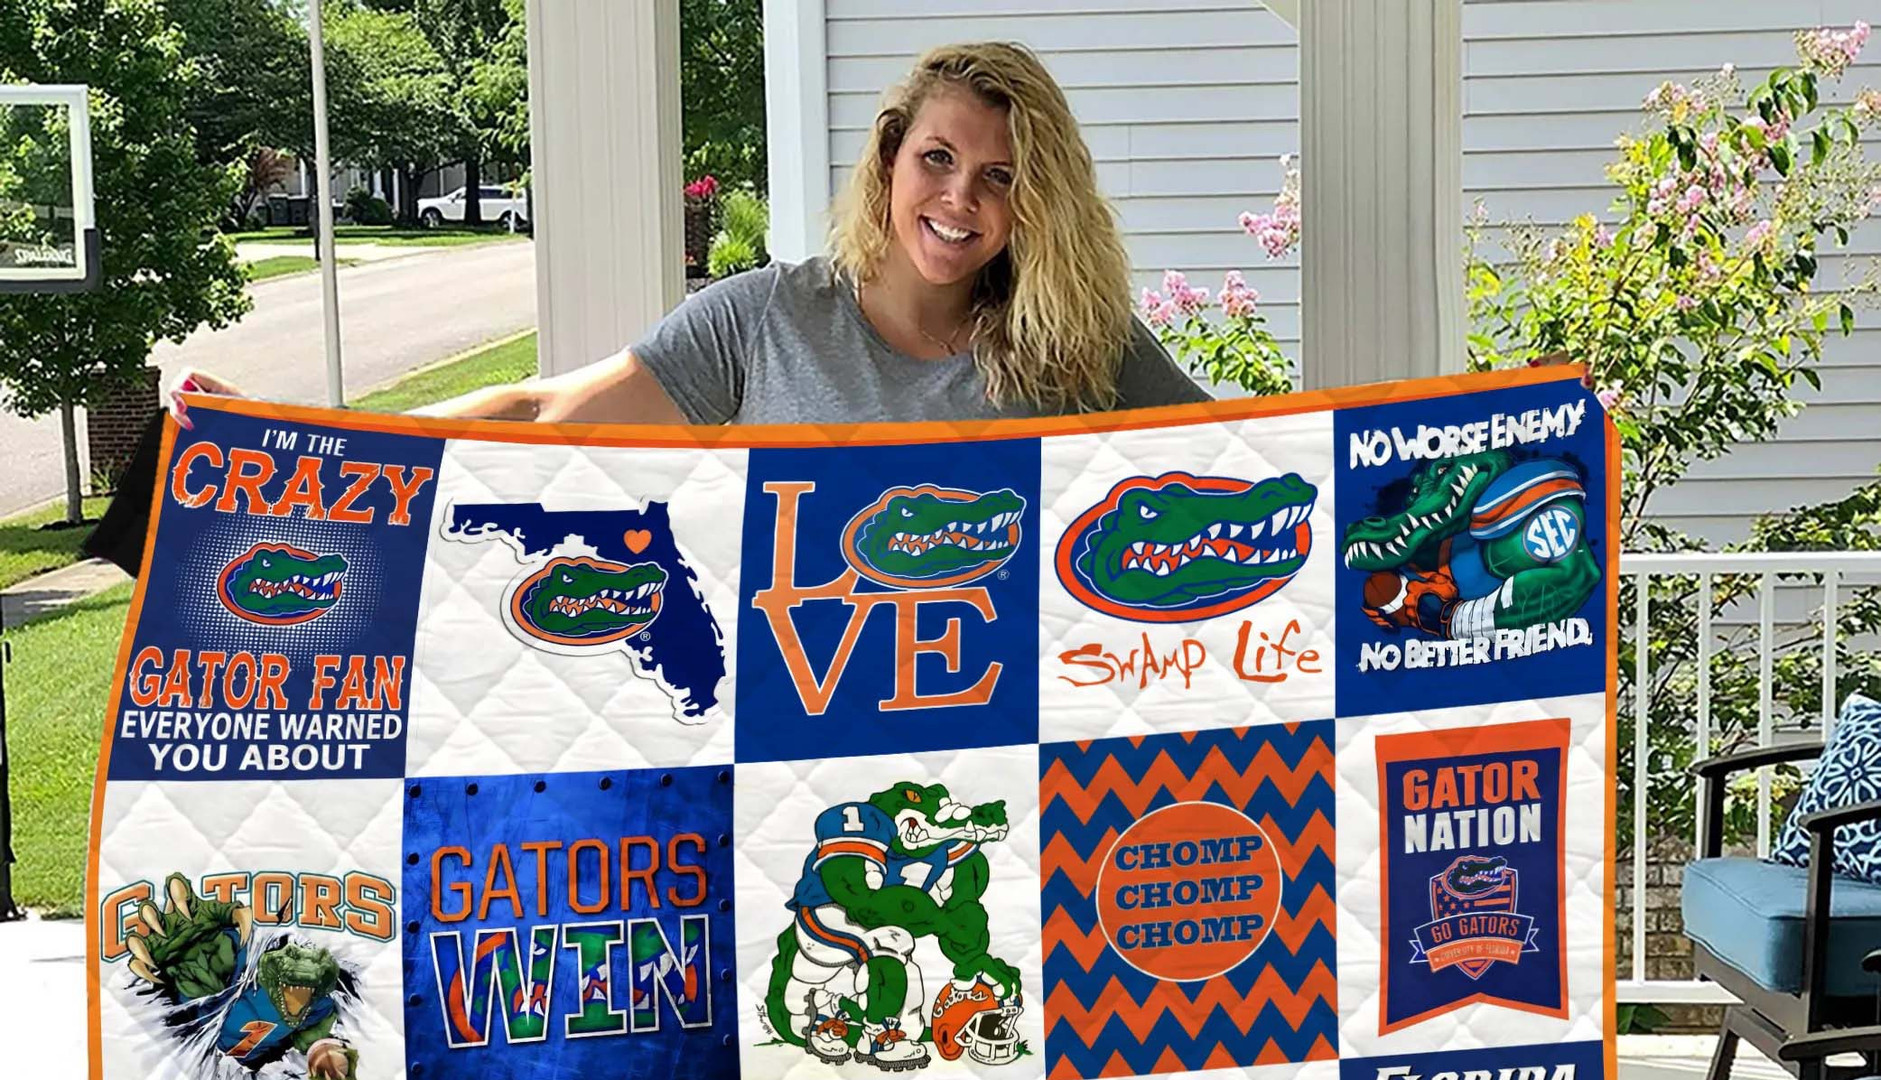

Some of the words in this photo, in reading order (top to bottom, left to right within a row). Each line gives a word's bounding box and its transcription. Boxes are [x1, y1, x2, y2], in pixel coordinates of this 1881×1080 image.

[262, 429, 298, 450] I'M
[307, 434, 347, 457] THE
[1349, 429, 1393, 469] NO
[1391, 421, 1489, 461] WORSE
[1491, 398, 1587, 450] ENEMY
[172, 441, 434, 526] CRAZY
[1526, 510, 1579, 560] SEC
[1233, 619, 1322, 683] Life
[1358, 641, 1402, 673] NO
[1404, 635, 1493, 669] BETTER
[129, 646, 291, 710] GATOR
[309, 655, 406, 711] FAN
[121, 711, 270, 740] EVERYONE
[280, 714, 402, 740] WARNED
[148, 744, 229, 772] YOU
[239, 744, 370, 771] ABOUT
[1402, 759, 1541, 811] GATOR
[842, 806, 864, 832] 1
[1403, 803, 1541, 853] NATION
[430, 832, 708, 923] GATORS
[1114, 835, 1263, 871] CHOMP
[100, 870, 397, 964] GTORS
[1115, 874, 1264, 911] CHOMP
[1116, 914, 1265, 950] CHOMP
[1430, 922, 1451, 943] GO
[1459, 916, 1520, 938] GATORS
[429, 913, 712, 1049] WIN
